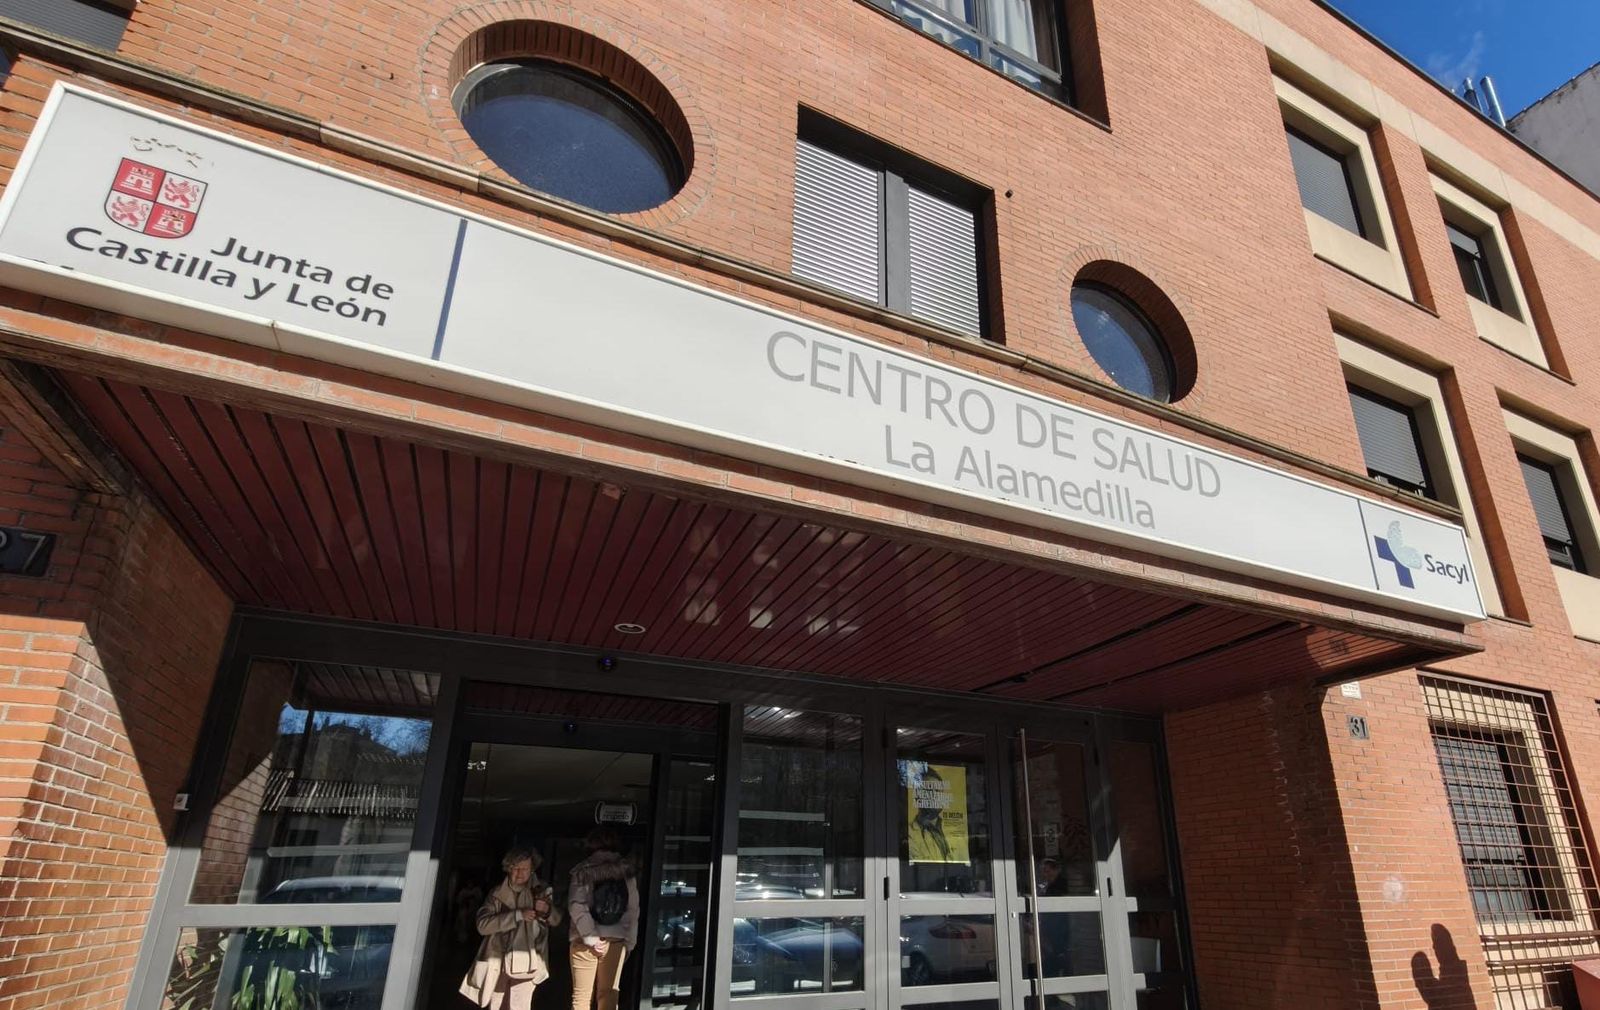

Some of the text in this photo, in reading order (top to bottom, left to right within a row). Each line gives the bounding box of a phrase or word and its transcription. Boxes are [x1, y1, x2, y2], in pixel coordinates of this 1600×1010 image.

[66, 227, 387, 326] Castilla y León
[211, 237, 394, 301] Junta de
[766, 330, 1221, 498] CENTRO DE SALUD
[884, 424, 1155, 529] La Alamedilla
[1424, 553, 1469, 585] Sacyl
[1351, 717, 1367, 737] 31
